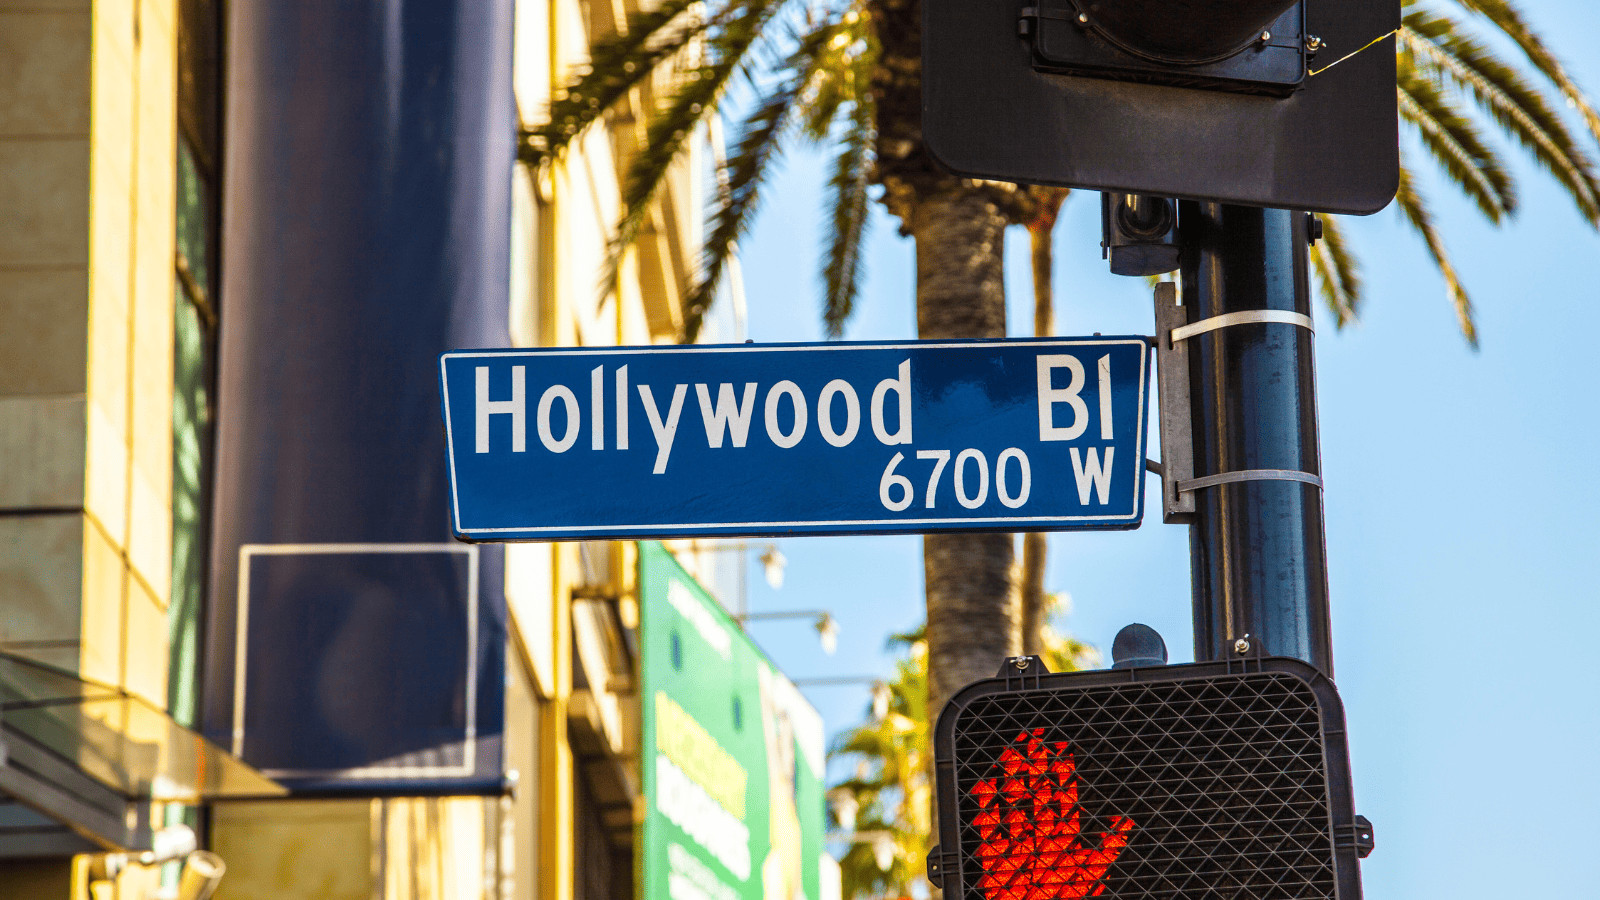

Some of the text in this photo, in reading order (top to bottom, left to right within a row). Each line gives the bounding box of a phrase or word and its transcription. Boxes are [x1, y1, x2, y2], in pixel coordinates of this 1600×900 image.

[475, 353, 1114, 475] Hollywood Bl
[879, 446, 1115, 512] 6700 W
